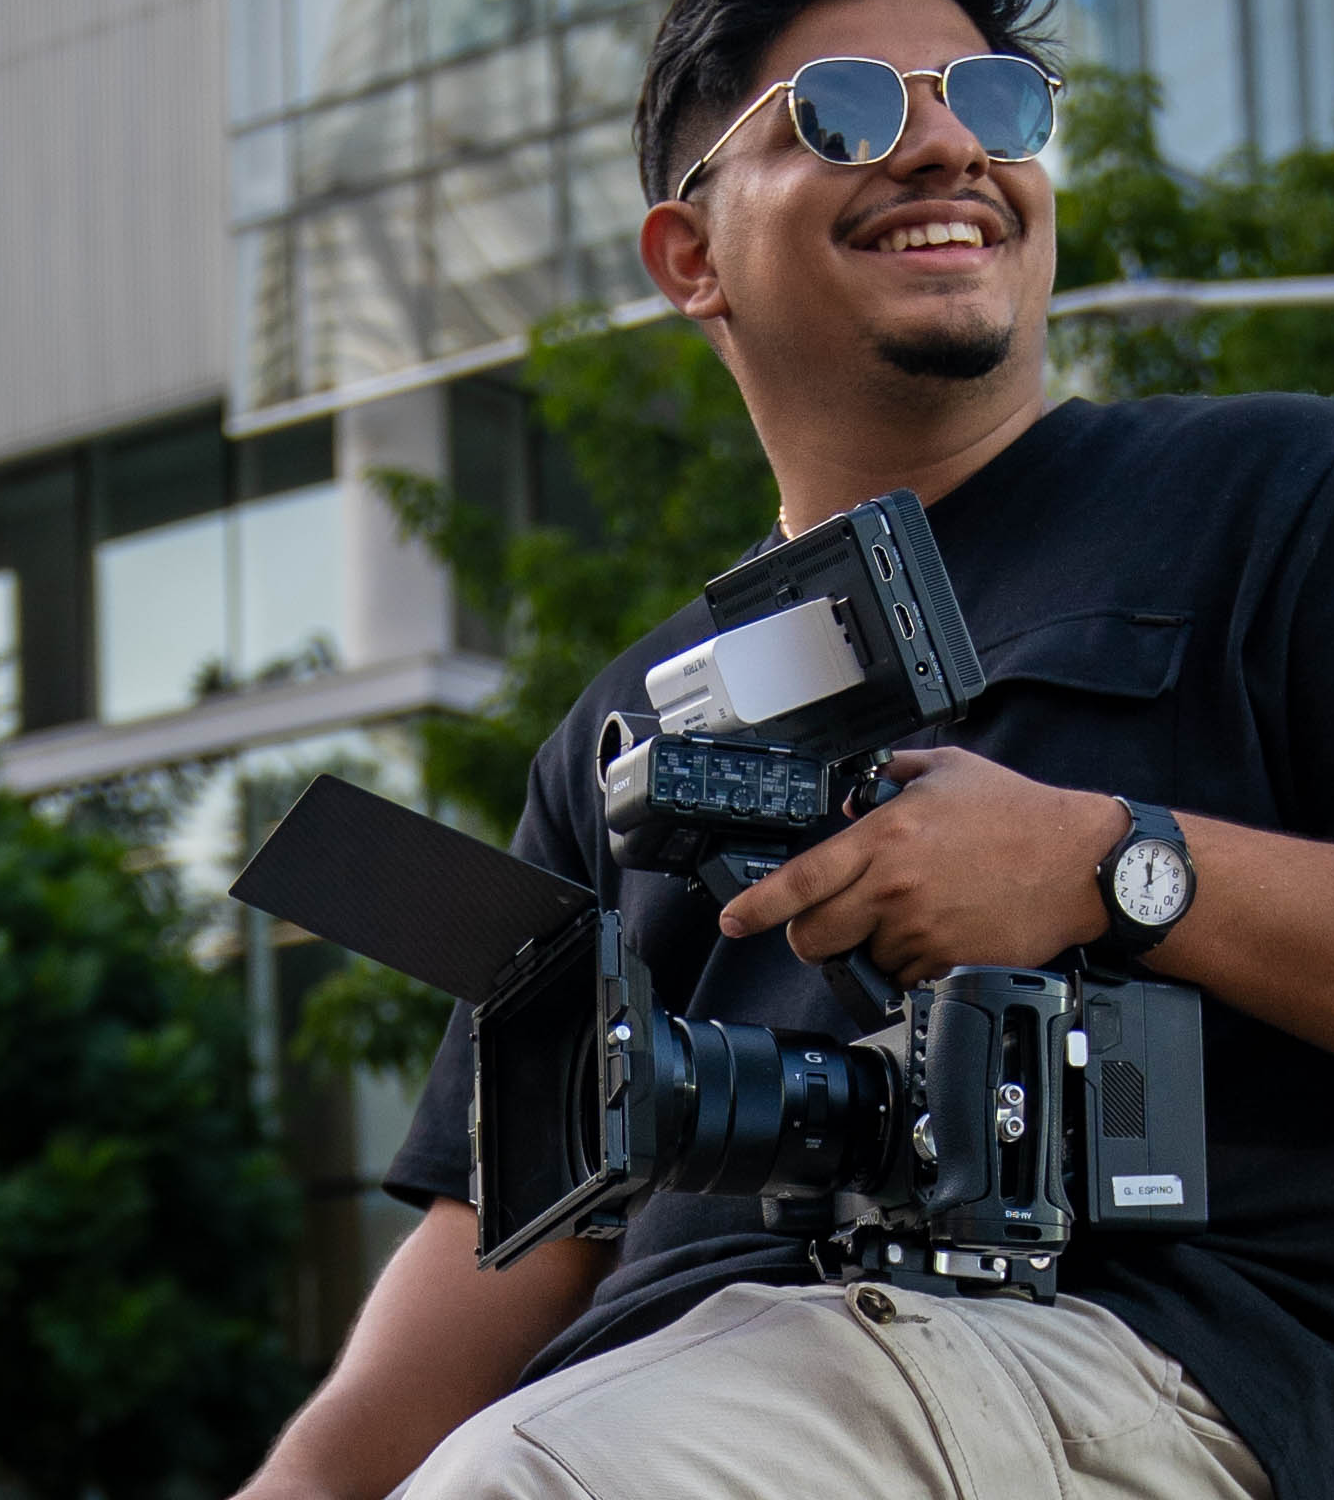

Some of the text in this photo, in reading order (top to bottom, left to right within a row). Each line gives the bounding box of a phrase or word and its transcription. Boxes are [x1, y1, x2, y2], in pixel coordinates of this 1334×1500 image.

[1138, 848, 1145, 859] 5
[1119, 871, 1127, 881] 3
[1172, 868, 1180, 878] 8
[1120, 887, 1128, 898] 2
[1163, 895, 1174, 906] 10
[1138, 904, 1149, 916] 12
[1154, 904, 1162, 915] 11
[804, 1052, 822, 1064] G
[1123, 1185, 1173, 1196] G. ESPINO
